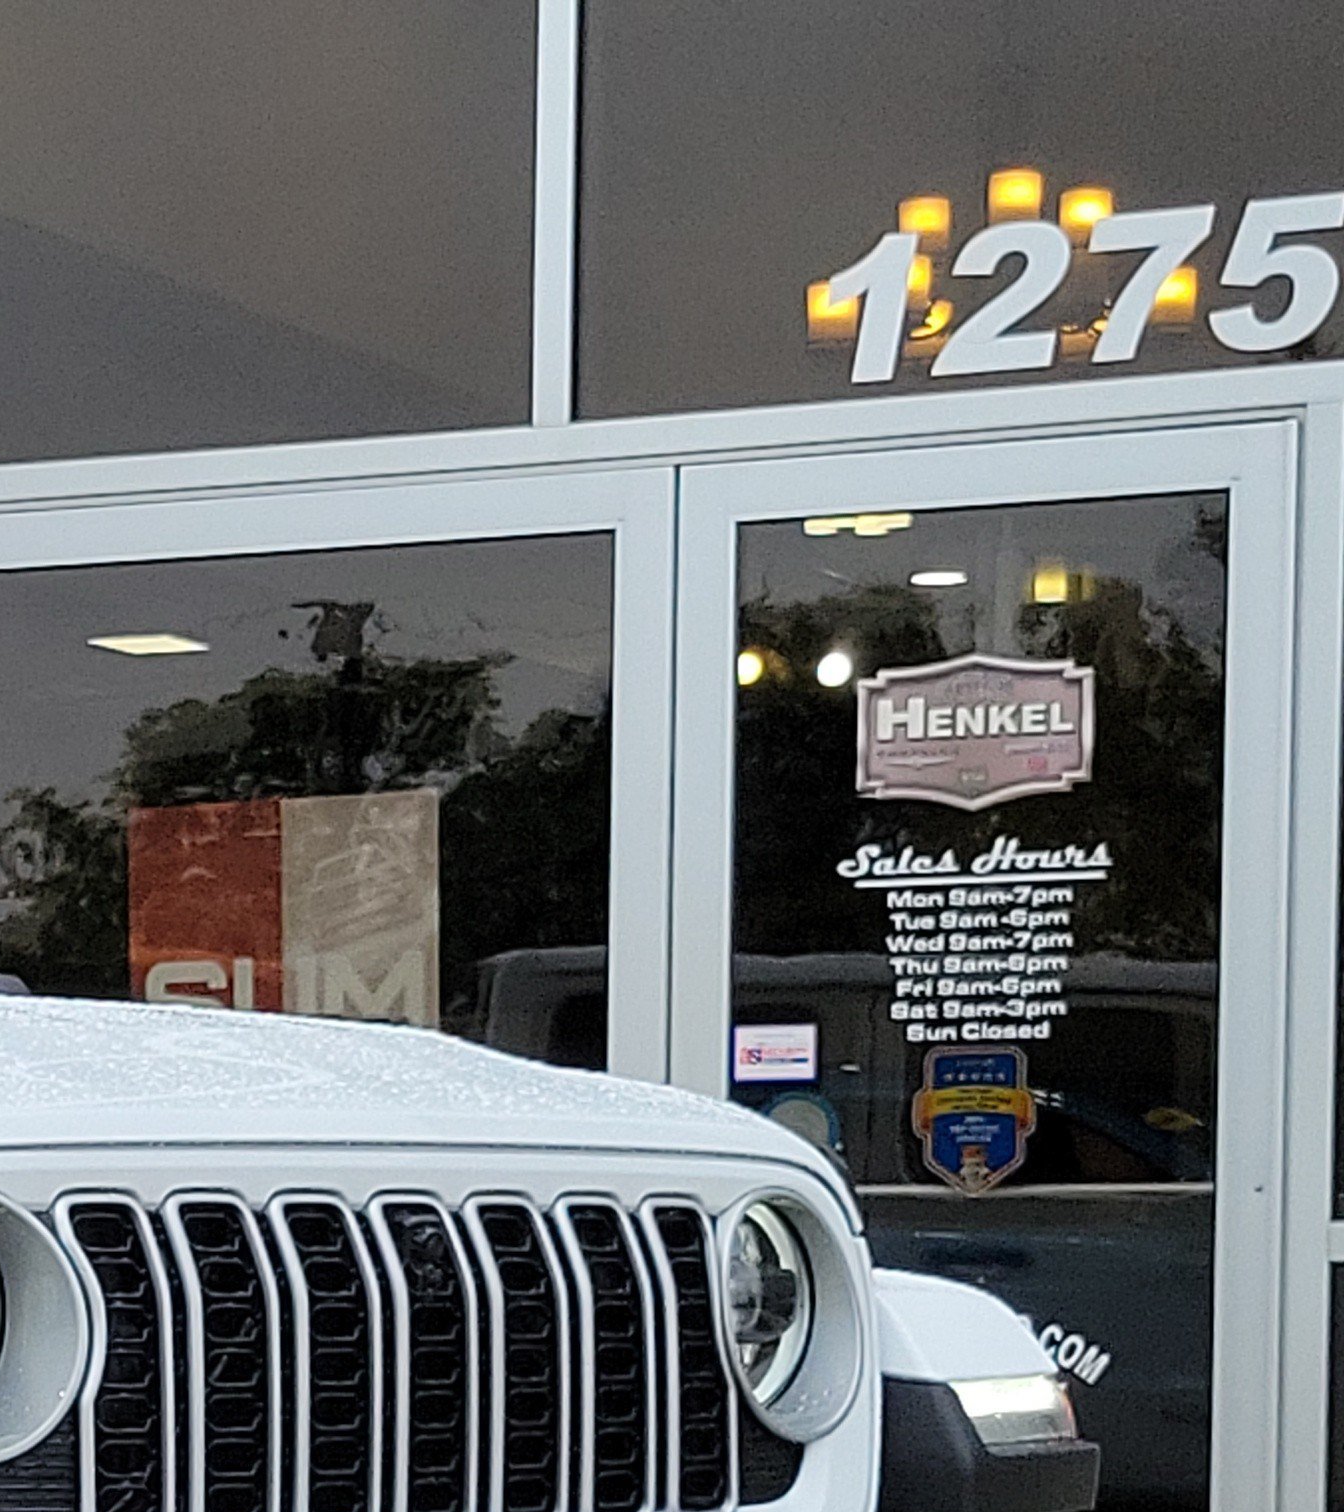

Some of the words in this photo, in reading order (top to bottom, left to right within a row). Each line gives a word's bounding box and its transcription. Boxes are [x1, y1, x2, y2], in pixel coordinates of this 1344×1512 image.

[828, 190, 1344, 385] 1275
[875, 696, 1077, 742] HENKEL
[835, 843, 960, 877] Sales
[970, 834, 1114, 875] Hours
[886, 890, 944, 909] Mon
[948, 885, 1074, 907] 9am-7pm
[889, 912, 936, 931] Tue
[886, 934, 945, 954] Wed
[948, 931, 1074, 952] 9am-7pm
[889, 957, 939, 976] Thu
[895, 978, 934, 998] Fri
[890, 1001, 939, 1020] Sat
[906, 1023, 958, 1042] Sun
[961, 1020, 1051, 1041] Closed
